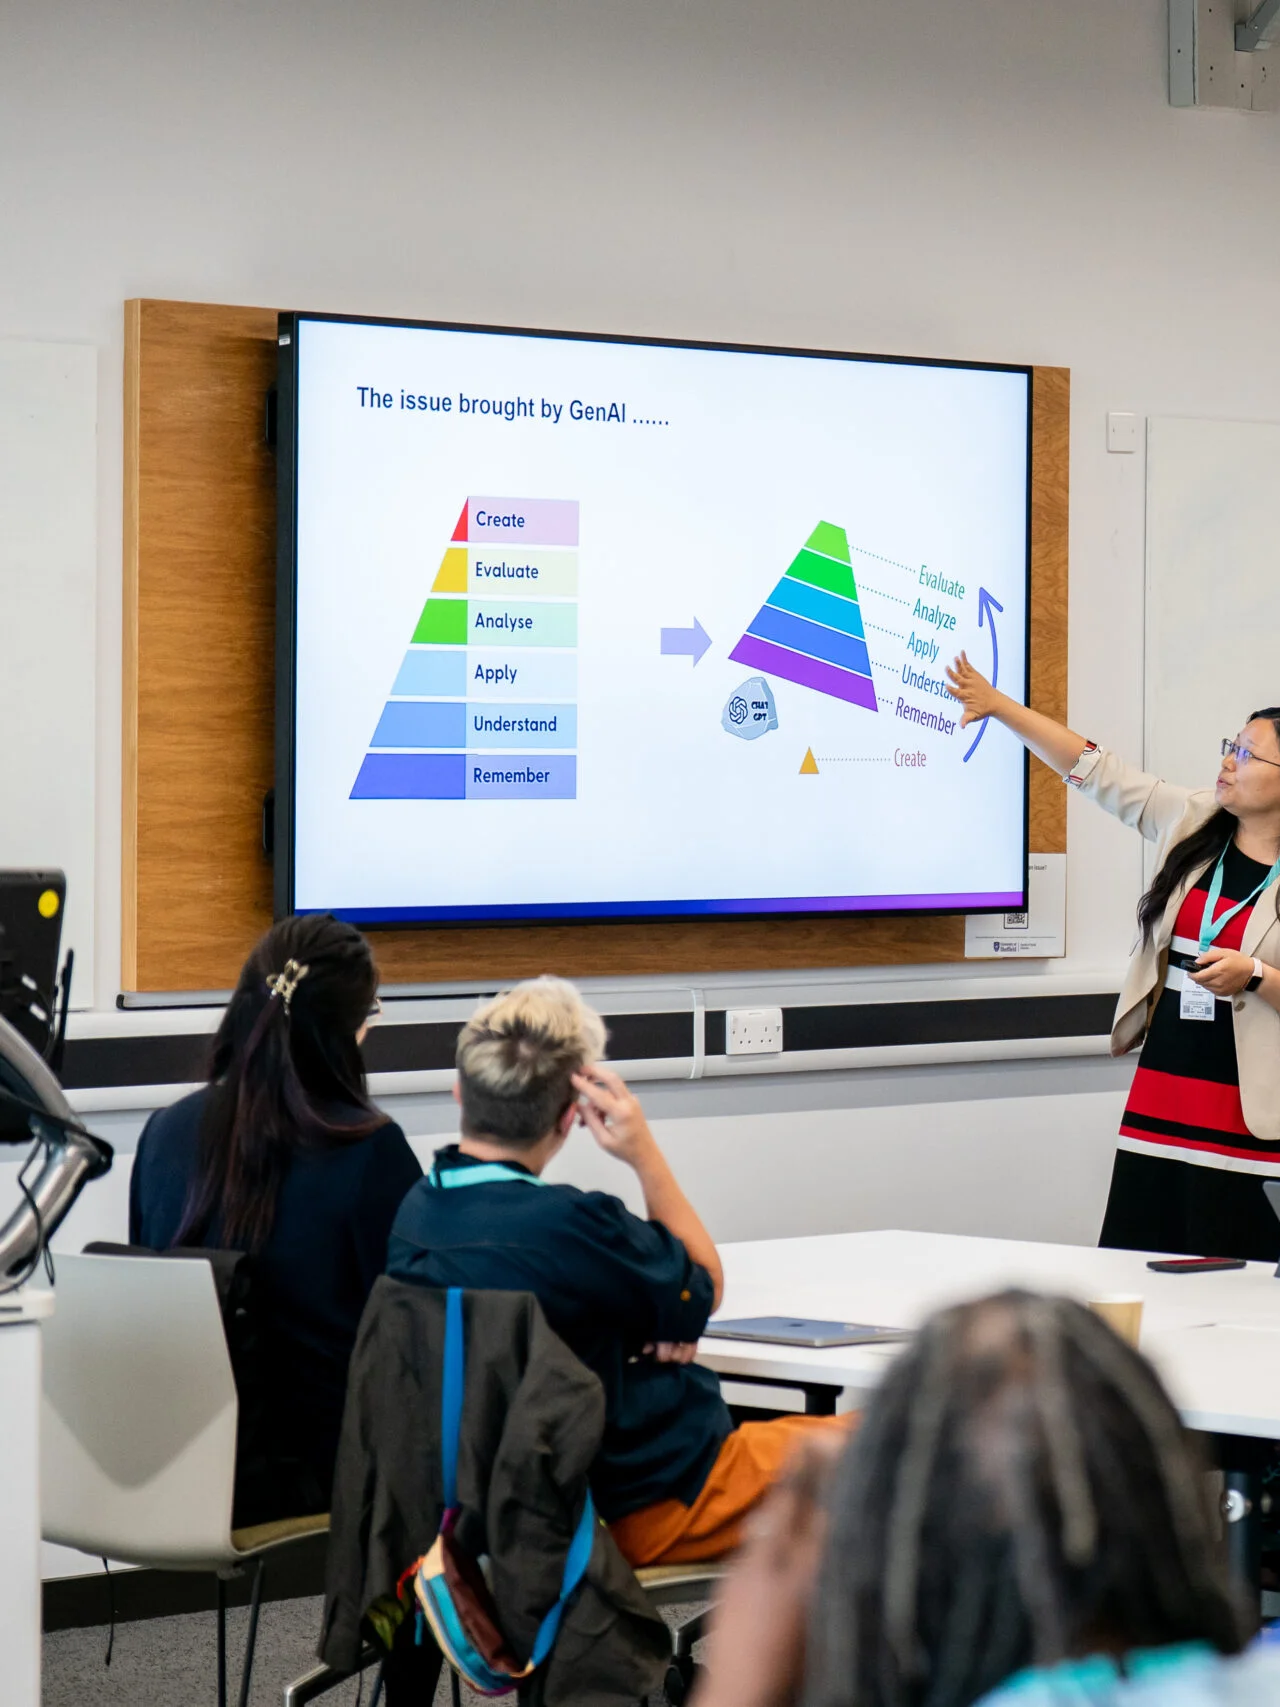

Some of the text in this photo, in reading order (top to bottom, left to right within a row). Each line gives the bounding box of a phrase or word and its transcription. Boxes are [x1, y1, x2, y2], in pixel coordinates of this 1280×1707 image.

[356, 386, 393, 409] The
[400, 389, 452, 412] issue
[459, 392, 535, 421] brought
[541, 397, 563, 424] by
[569, 399, 626, 423] GenAI
[476, 510, 525, 528] Create
[475, 561, 539, 579] Evaluate
[918, 564, 965, 600] Evaluate
[474, 612, 533, 632] Analyse
[912, 597, 957, 631] Analyze
[906, 631, 940, 664] Apply
[474, 663, 518, 684] Apply
[751, 701, 769, 710] CHAT
[473, 715, 557, 732] Understand
[753, 712, 767, 721] GPT
[895, 696, 957, 736] Remember
[894, 747, 927, 767] Create
[473, 766, 550, 783] Remember
